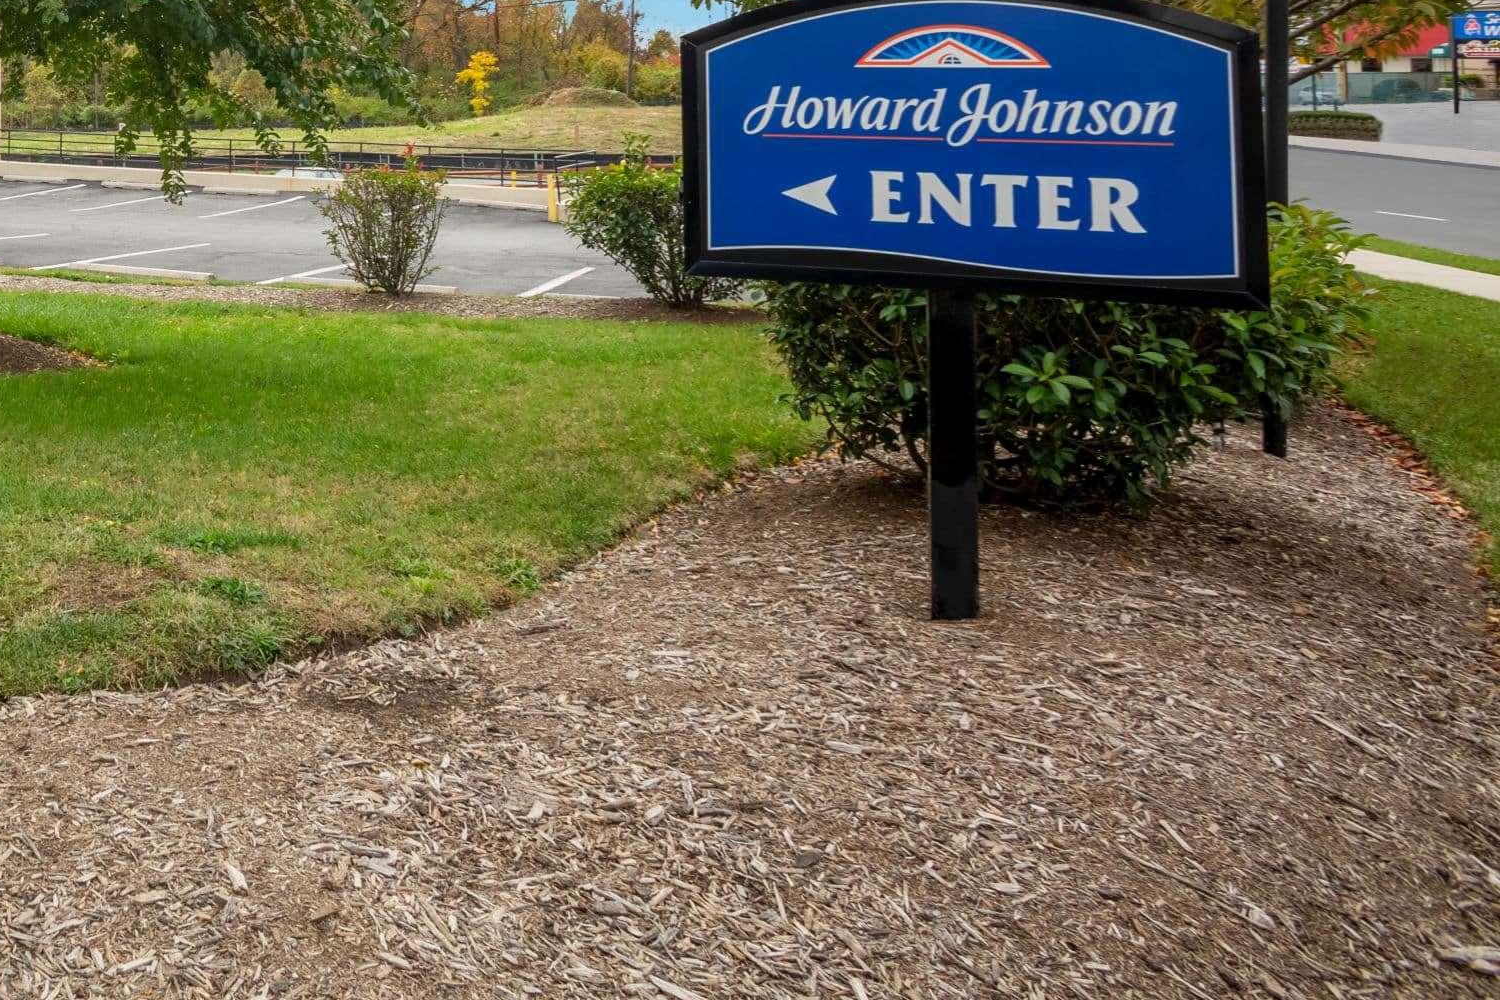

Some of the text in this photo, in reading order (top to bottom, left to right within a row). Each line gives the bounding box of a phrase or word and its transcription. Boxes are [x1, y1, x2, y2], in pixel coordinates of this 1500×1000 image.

[743, 83, 1178, 147] Howard Johnson
[869, 170, 1148, 234] ENTER
